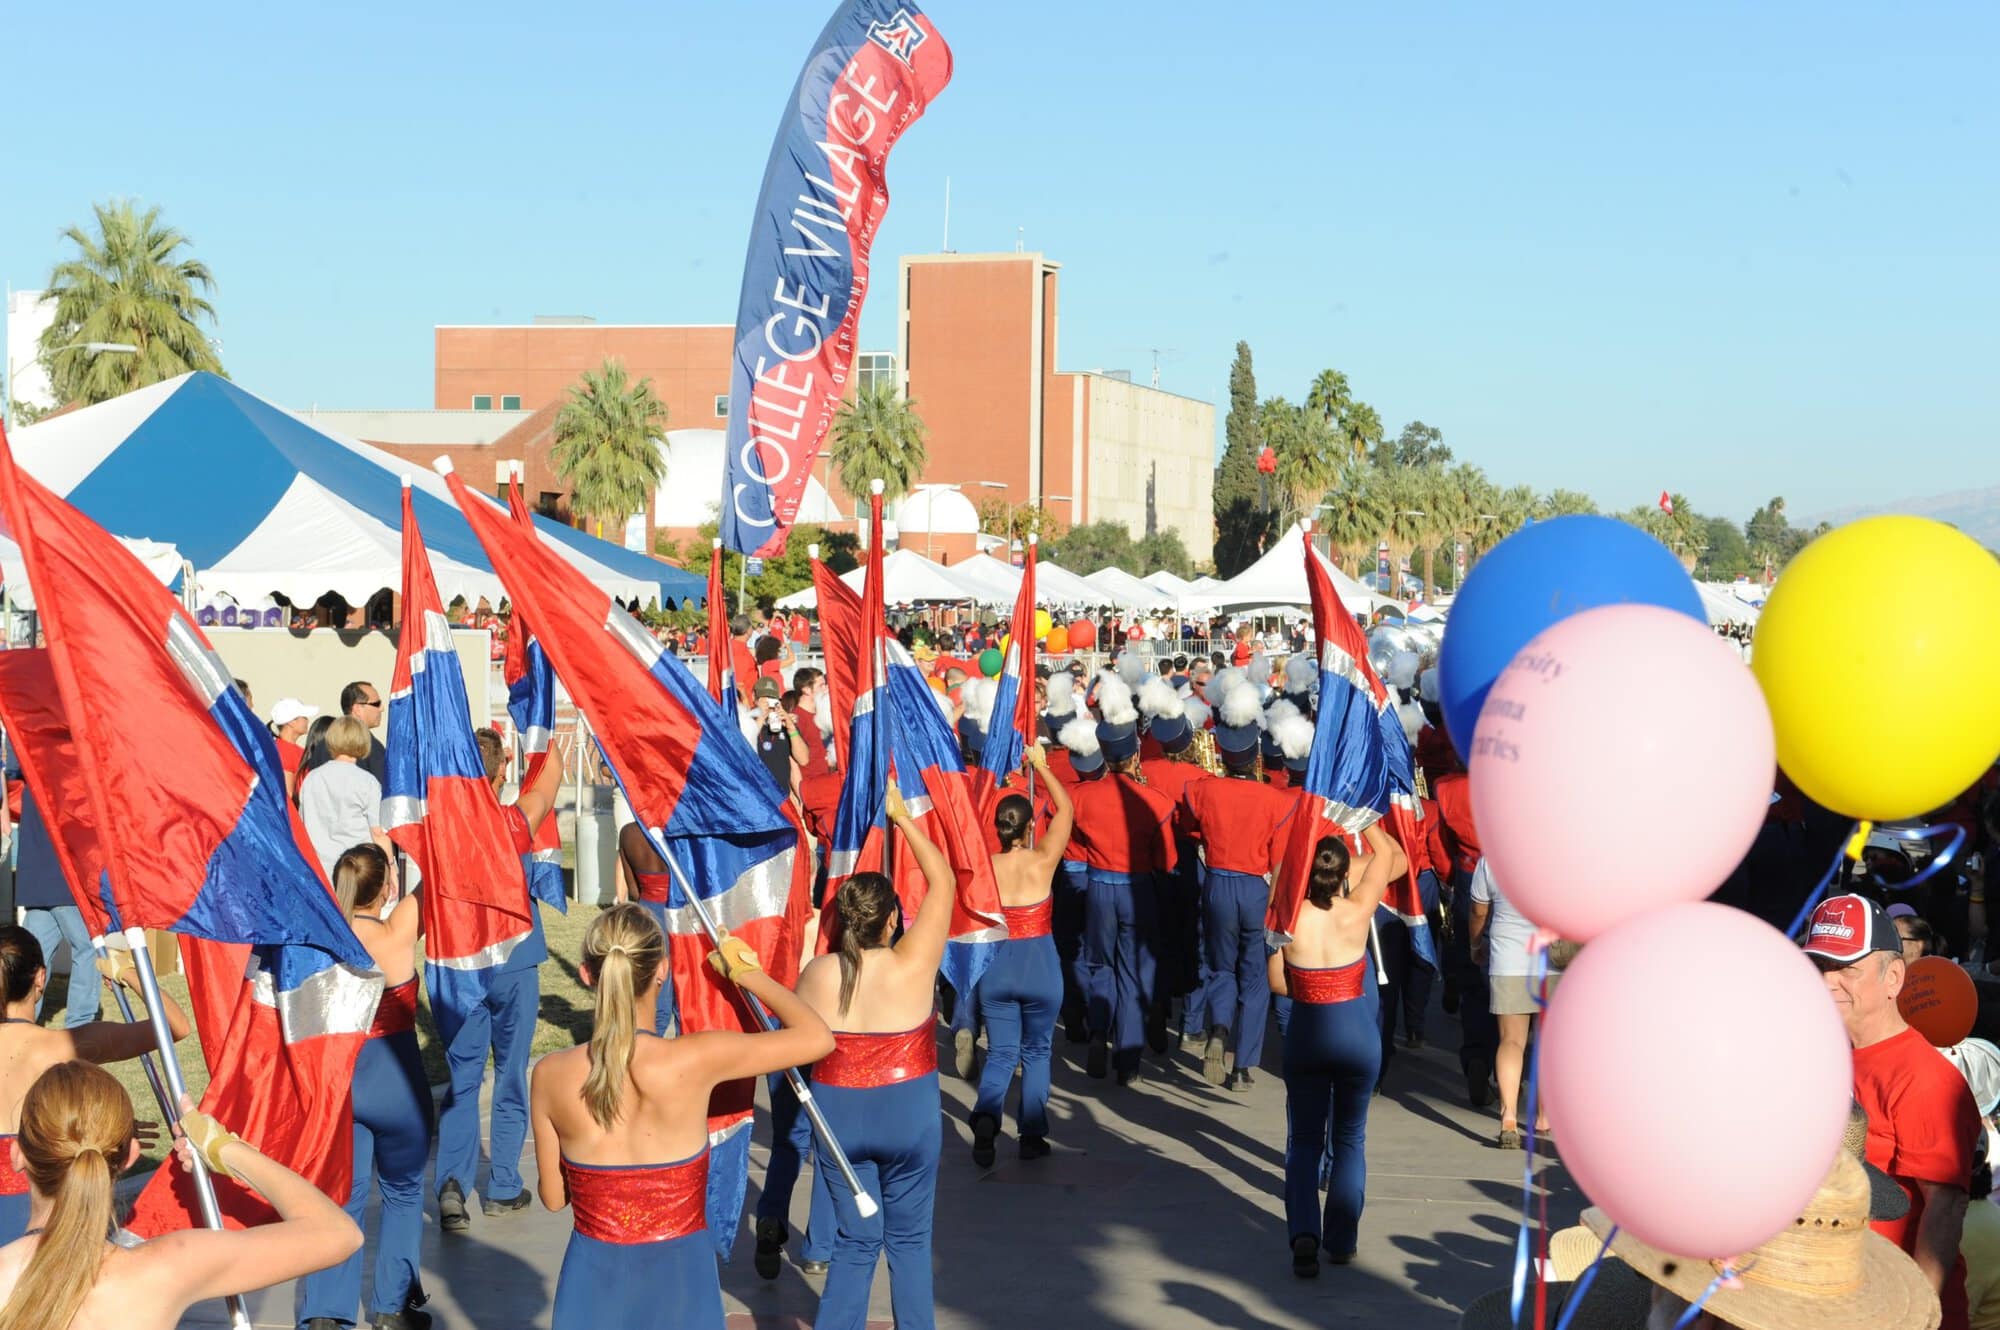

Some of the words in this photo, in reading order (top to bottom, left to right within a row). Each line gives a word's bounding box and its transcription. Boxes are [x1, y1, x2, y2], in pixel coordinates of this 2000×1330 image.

[733, 277, 830, 528] COLLEGE
[783, 60, 899, 257] VILLAGE
[839, 275, 867, 354] ARIZONA
[832, 360, 848, 384] OF
